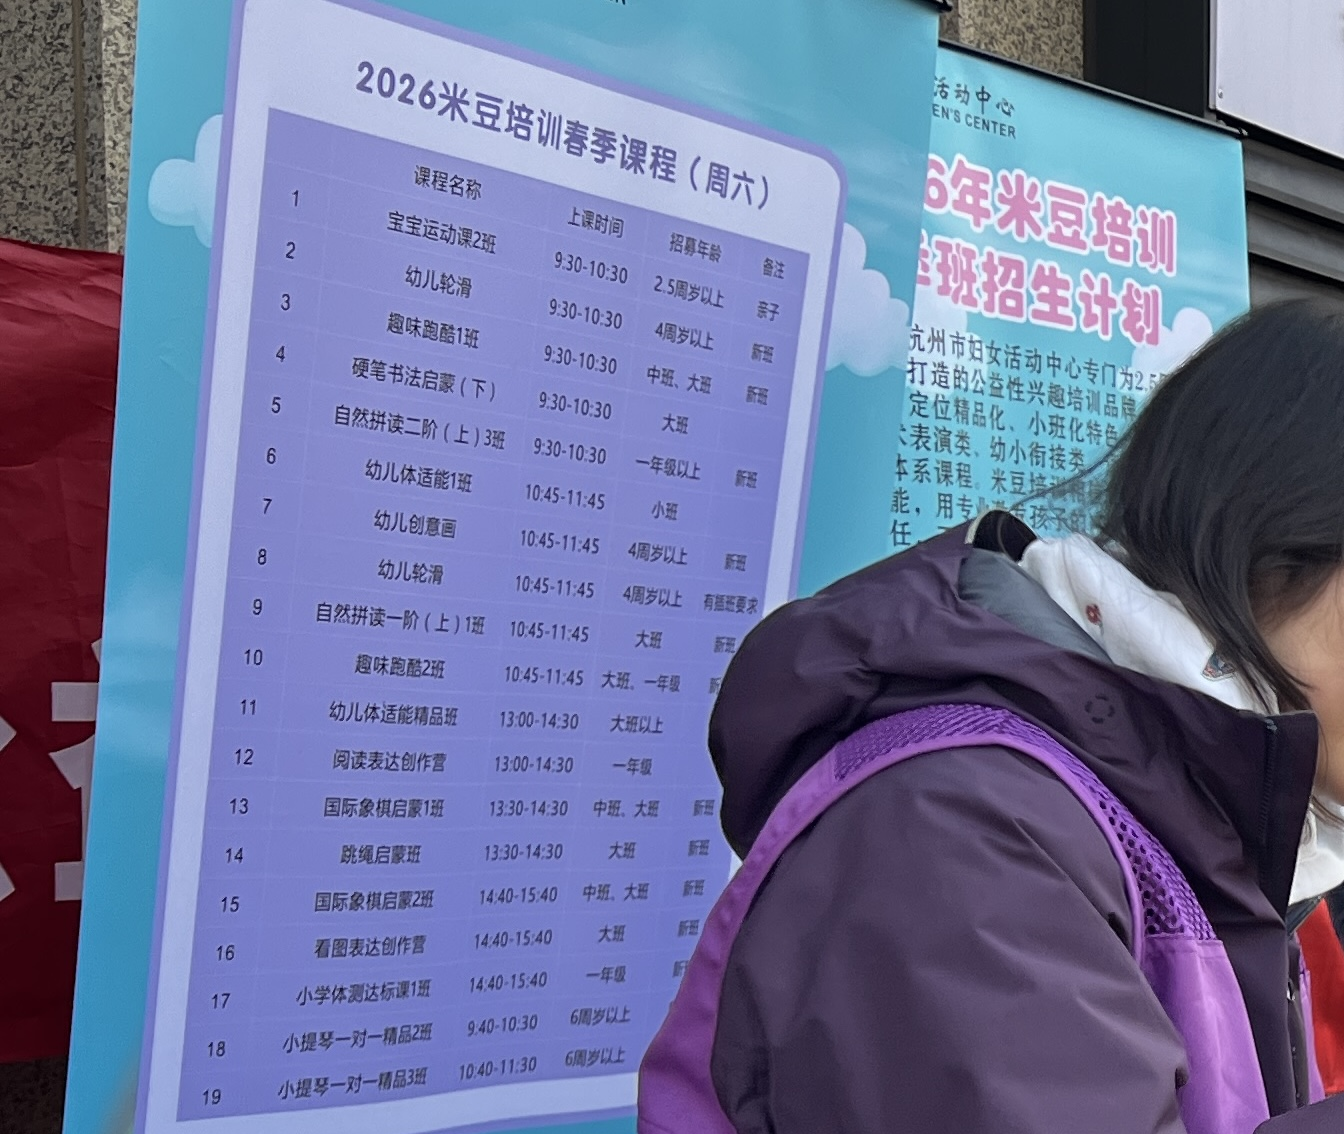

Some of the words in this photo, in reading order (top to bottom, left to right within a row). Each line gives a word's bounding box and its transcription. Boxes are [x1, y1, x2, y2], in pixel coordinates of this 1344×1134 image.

[356, 61, 769, 210] 2026米豆培训春季课程（周六）
[965, 112, 1017, 139] CENTER
[415, 165, 481, 200] 课程名称
[568, 207, 624, 238] 上课时间
[669, 233, 721, 262] 招募年龄
[291, 190, 299, 207] 1
[387, 211, 496, 254] 宝宝运动课2班
[555, 251, 628, 284] 9:30-10:30
[654, 275, 724, 308] 2.5周岁以上
[285, 242, 296, 259] 2
[405, 265, 472, 298] 幼儿轮滑
[550, 298, 622, 329] 9:30-10:30
[655, 323, 713, 350] 4周岁以上
[280, 294, 291, 311] 3
[387, 312, 479, 349] 趣味跑酷1班
[544, 345, 617, 374] 9:30-10:30
[910, 324, 1166, 394] 杭州市妇女活动中心专门为2.5
[275, 345, 286, 362] 4
[539, 391, 611, 420] 9:30-10:30
[662, 414, 688, 434] 大班
[271, 396, 281, 414] 5
[534, 438, 606, 464] 9:30-10:30
[635, 456, 700, 480] 一年级以上
[266, 447, 276, 464] 6
[365, 459, 472, 493] 幼儿体适能1班
[526, 484, 605, 510] 10:45-11:45
[652, 501, 678, 521] 小班
[263, 498, 272, 514] 7
[374, 510, 456, 538] 幼儿创意画
[521, 530, 599, 554] 10:45-11:45
[628, 542, 687, 565] 4周岁以上
[257, 549, 267, 566] 8
[378, 559, 443, 585] 幼儿轮滑
[516, 575, 594, 598] 10:45-11:45
[623, 586, 682, 608] 4周岁以上
[252, 599, 262, 616] 9
[511, 621, 589, 642] 10:45-11:45
[635, 630, 663, 649] 大班
[244, 649, 263, 666] 10
[355, 654, 445, 679] 趣味跑酷2班
[506, 667, 583, 686] 10:45-11:45
[240, 699, 257, 716] 11
[329, 701, 458, 726] 幼儿体适能精品班
[501, 711, 579, 729] 13:00-14:30
[610, 714, 663, 734] 大班以上
[235, 749, 253, 766] 12
[333, 749, 446, 772] 阅读表达创作营
[496, 756, 573, 773] 13:00-14:30
[612, 758, 652, 775] 一年级
[230, 798, 248, 815] 13
[324, 797, 444, 818] 国际象棋启蒙1班
[490, 800, 568, 817] 13:30-14:30
[225, 847, 243, 864] 14
[340, 845, 421, 864] 跳绳启蒙班
[485, 844, 563, 861] 13:30-14:30
[608, 842, 636, 859] 大班
[221, 896, 239, 913] 15
[314, 890, 434, 912] 国际象棋启蒙2班
[480, 887, 557, 904] 14:40-15:40
[216, 944, 234, 961] 16
[315, 935, 426, 958] 看图表达创作营
[475, 929, 552, 949] 14:40-15:40
[598, 925, 625, 942] 大班
[212, 993, 230, 1009] 17
[296, 979, 431, 1006] 小学体测达标课1班
[470, 972, 547, 993] 14:40-15:40
[586, 966, 626, 983] 一年级
[207, 1041, 226, 1058] 18
[283, 1023, 433, 1053] 小提琴一对一精品2班
[468, 1014, 538, 1037] 9:40-10:30
[570, 1006, 630, 1025] 6周岁以上
[203, 1089, 221, 1106] 19
[278, 1068, 428, 1100] 小提琴一对一精品3班
[458, 1056, 538, 1082] 10:40-11:30
[565, 1047, 625, 1068] 6周岁以上
